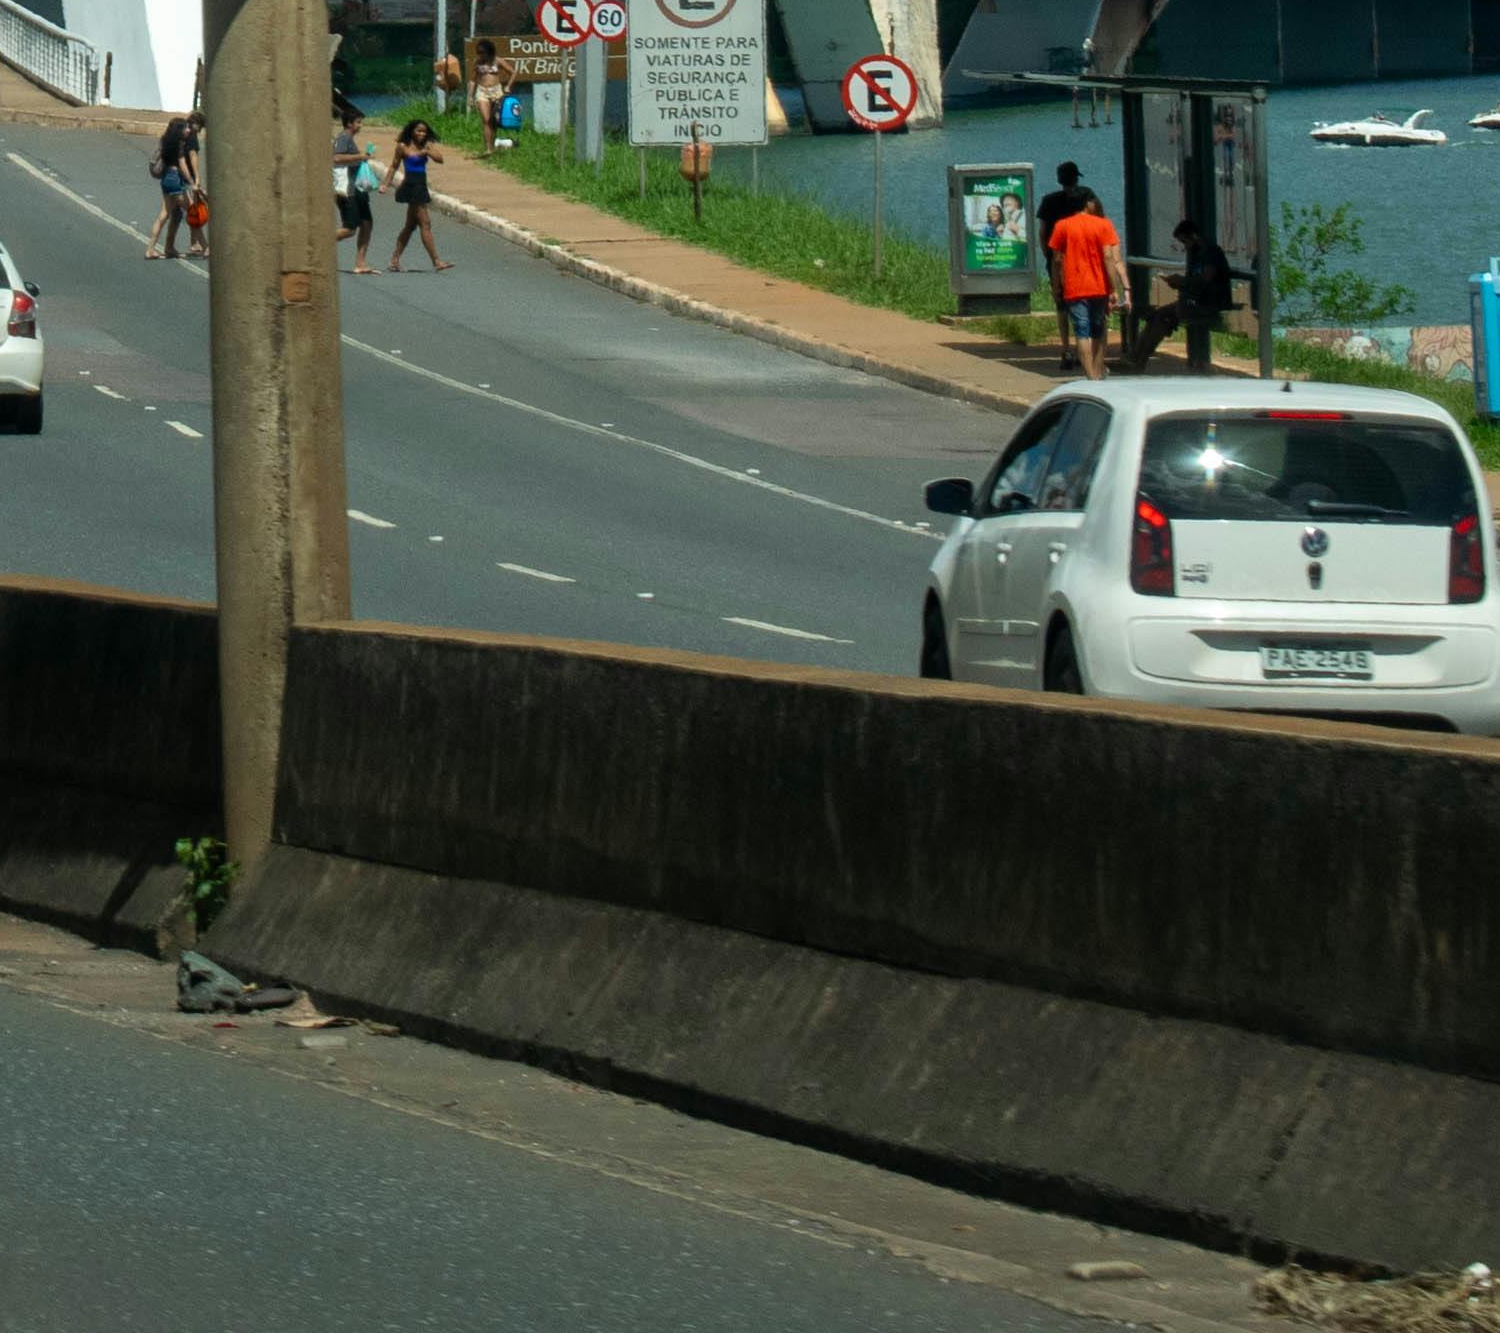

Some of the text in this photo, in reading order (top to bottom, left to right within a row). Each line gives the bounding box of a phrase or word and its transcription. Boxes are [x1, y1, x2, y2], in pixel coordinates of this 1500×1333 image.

[556, 0, 577, 34] E
[597, 9, 622, 27] 60
[509, 38, 558, 54] Ponte
[634, 36, 759, 50] SOMENTE PARA
[534, 59, 577, 76] Brig
[646, 53, 752, 67] VIATURAS DE
[647, 71, 748, 87] SEGURANÇA
[655, 85, 740, 102] PÚBLICA E
[866, 69, 894, 113] E
[658, 103, 739, 119] TRÂNSITO
[674, 123, 722, 137] INCIO
